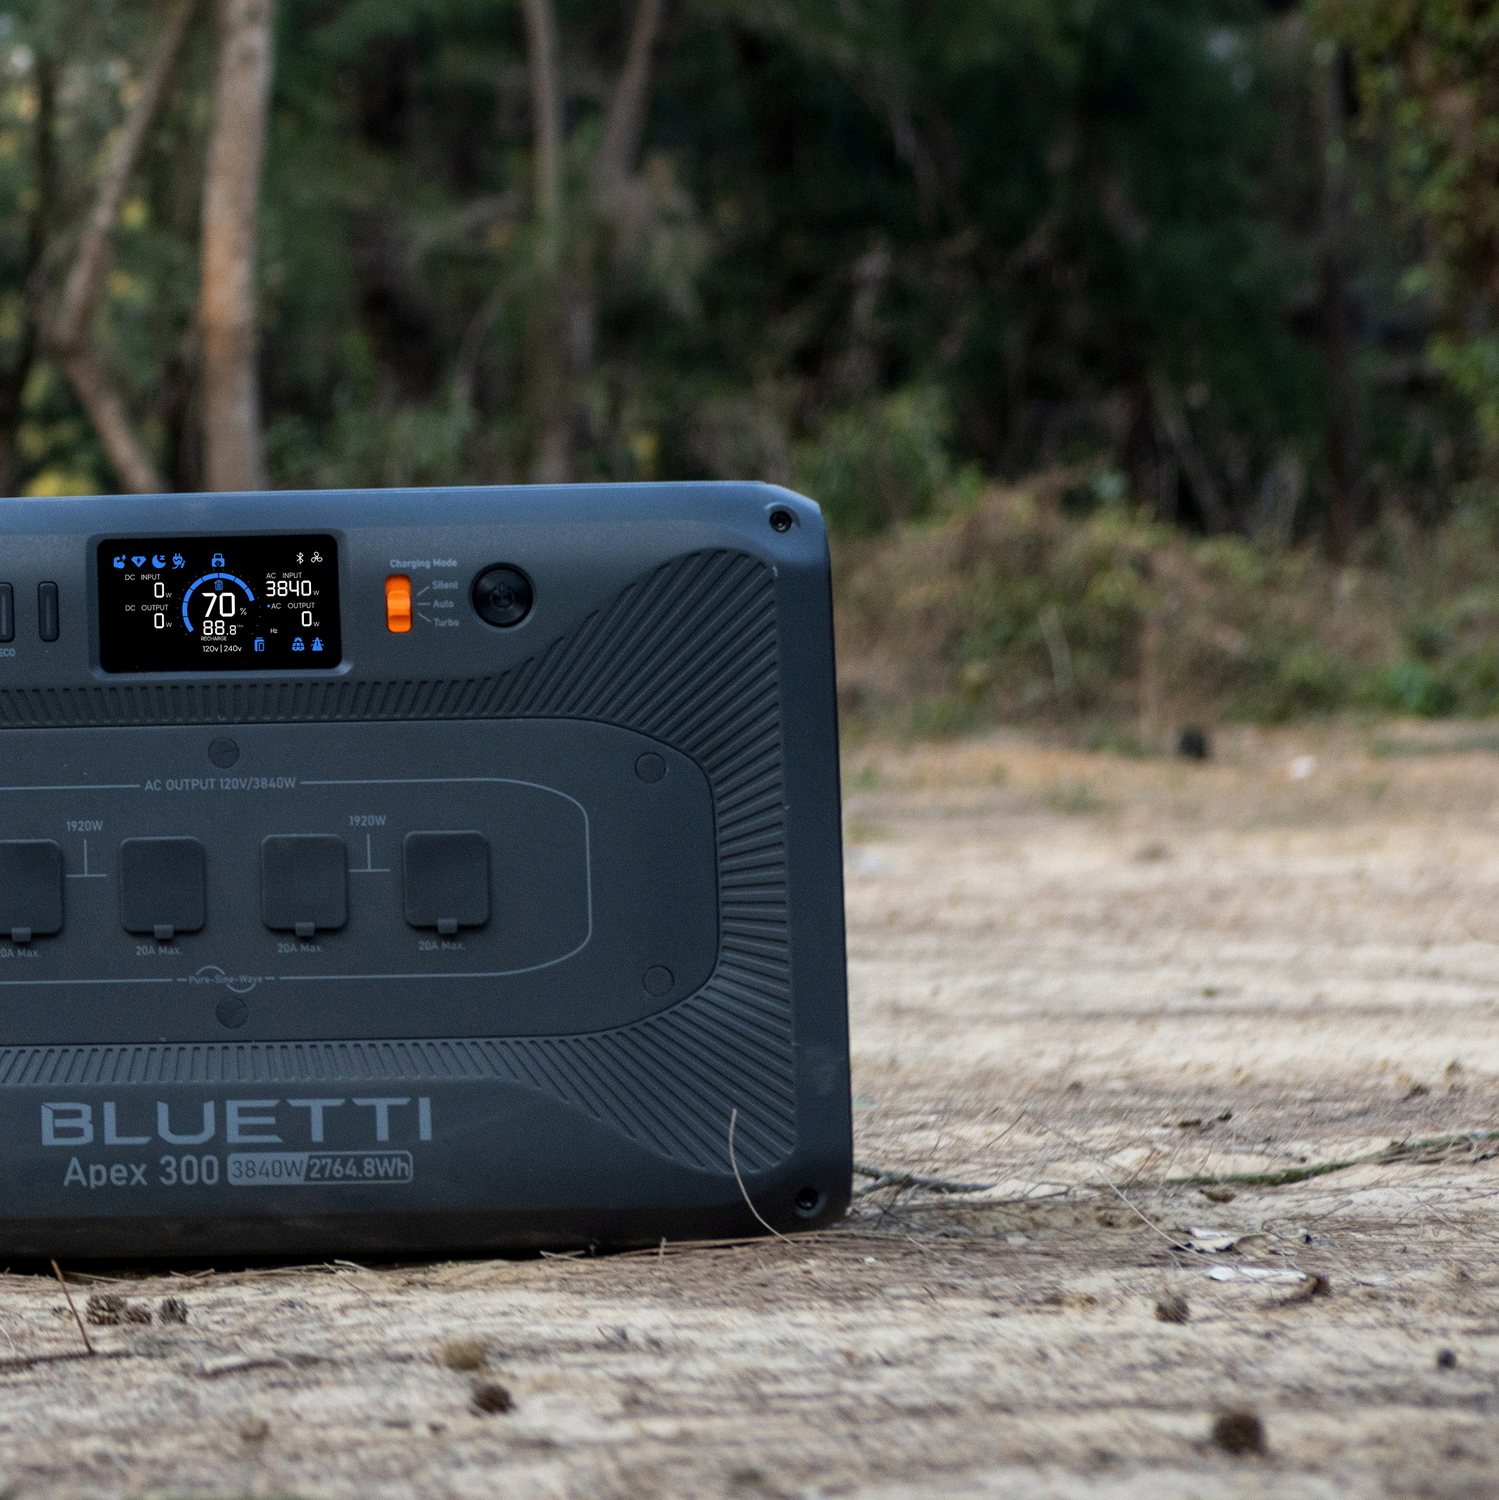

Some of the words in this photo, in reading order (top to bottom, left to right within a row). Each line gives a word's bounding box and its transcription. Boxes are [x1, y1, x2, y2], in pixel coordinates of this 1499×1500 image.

[389, 559, 431, 569] Charging
[433, 558, 457, 567] Mode
[140, 573, 161, 581] INPUT
[432, 580, 459, 590] Silent
[202, 592, 236, 617] 70
[240, 607, 248, 616] %
[433, 600, 454, 608] Auto
[434, 618, 460, 627] Turbo
[144, 779, 161, 791] AC
[166, 778, 216, 791] OUTPUT
[219, 777, 296, 791] 120V/3840W
[66, 820, 104, 832] 1920W
[349, 814, 387, 827] 1920W
[135, 946, 155, 956] 20A
[277, 942, 297, 953] 20A
[418, 940, 439, 951] 20A
[41, 1097, 432, 1146] BLUETTI
[63, 1156, 148, 1189] Apex
[159, 1154, 219, 1185] 300
[232, 1160, 304, 1179] 3840W
[309, 1158, 410, 1179] 2764.8Wh
